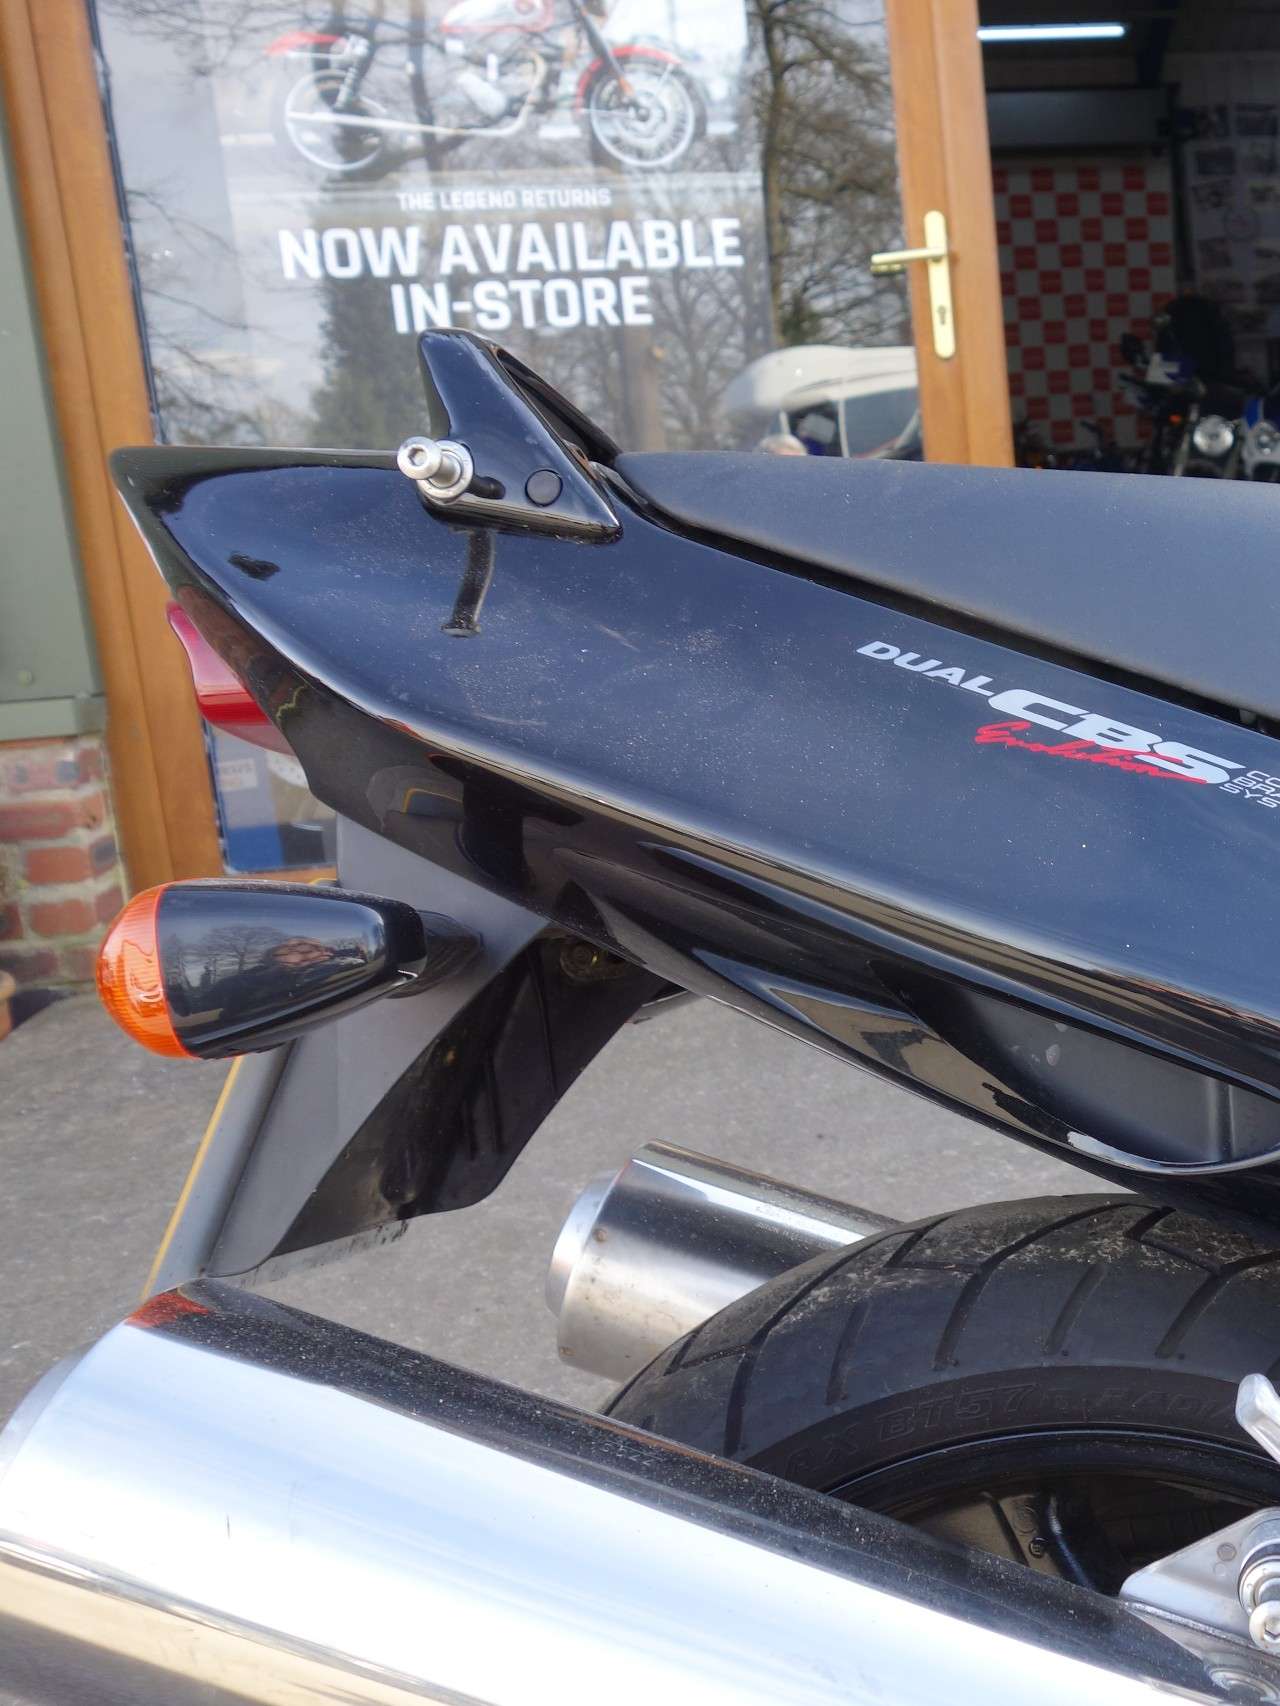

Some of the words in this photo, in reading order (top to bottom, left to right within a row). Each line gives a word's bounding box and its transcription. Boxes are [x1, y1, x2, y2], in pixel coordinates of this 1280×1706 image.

[396, 191, 437, 212] THE
[440, 189, 516, 211] LEGEND
[522, 187, 612, 209] RETURNS
[278, 226, 419, 280] NOW
[440, 218, 745, 276] AVAILABLE
[390, 276, 654, 334] IN-STORE
[856, 641, 995, 696] DUAL
[988, 689, 1246, 784] CBS
